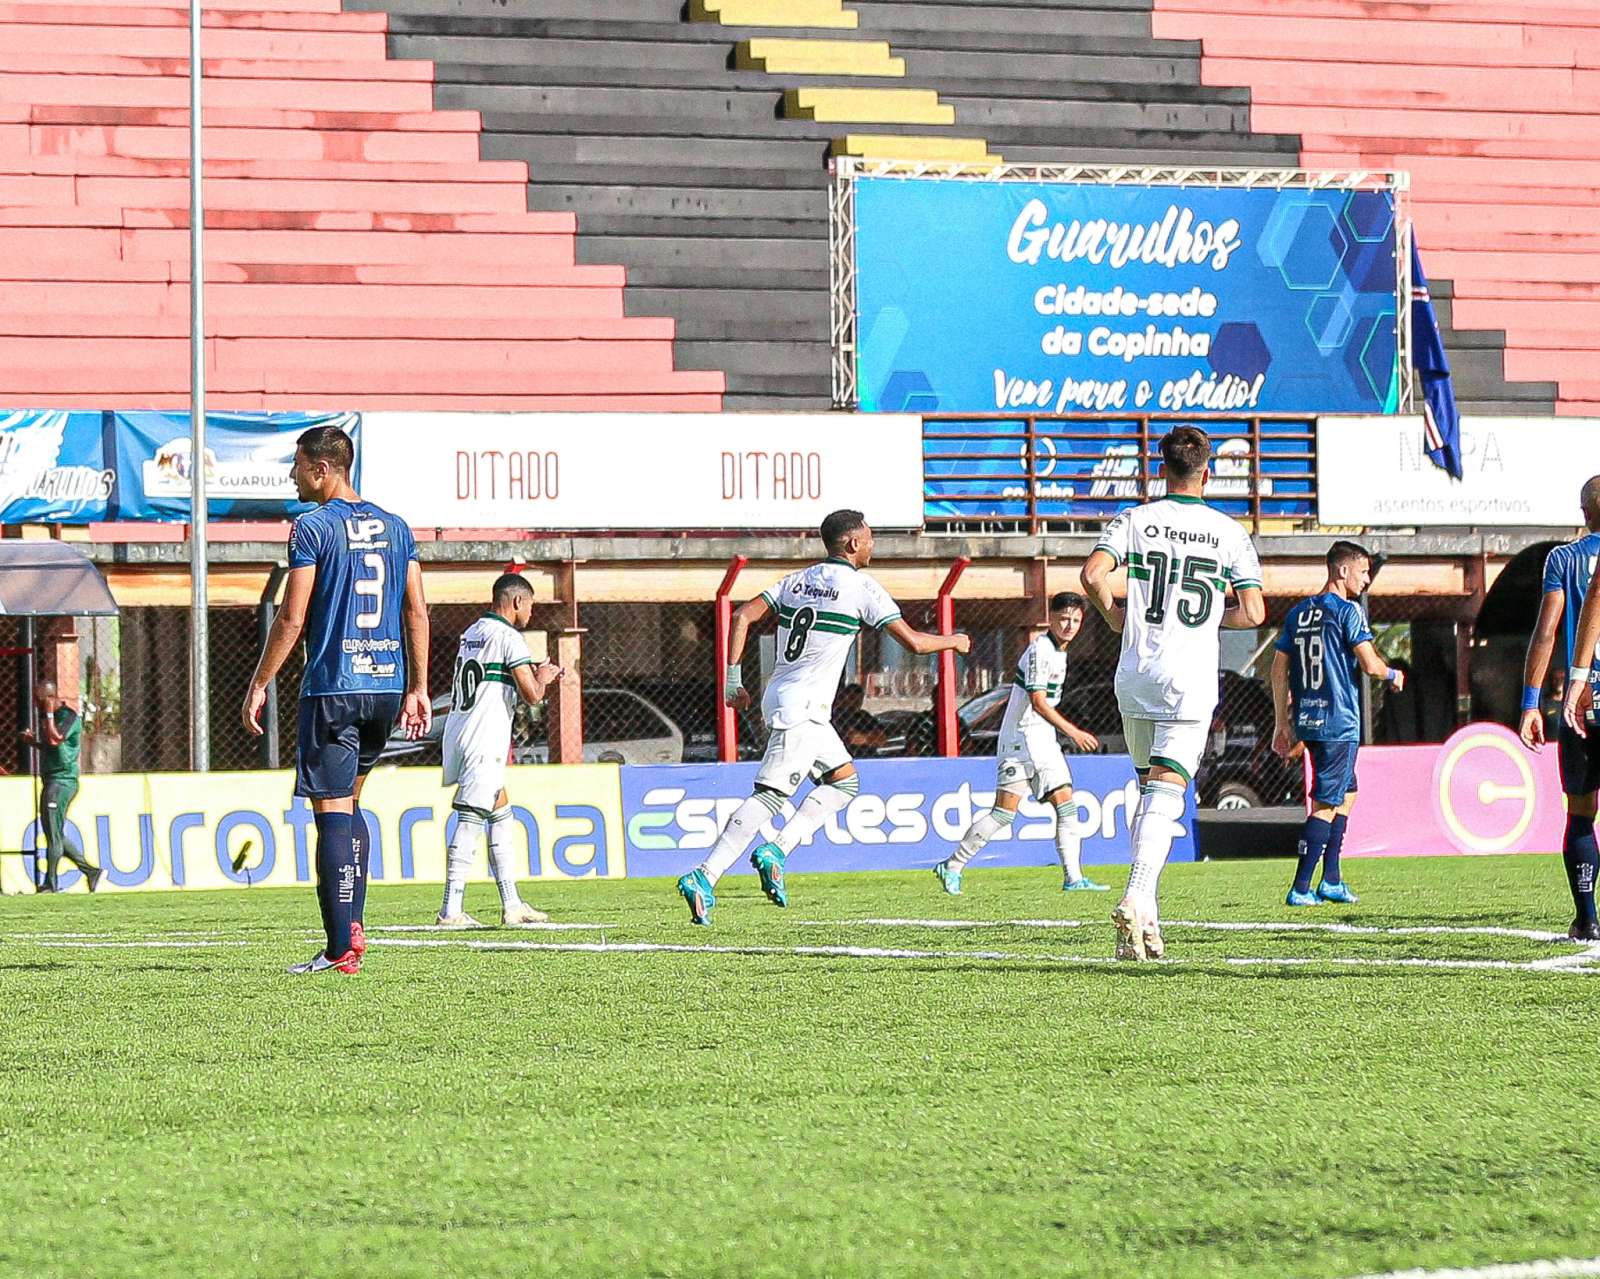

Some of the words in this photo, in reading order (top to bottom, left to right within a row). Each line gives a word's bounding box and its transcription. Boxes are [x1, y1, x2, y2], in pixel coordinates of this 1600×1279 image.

[1007, 199, 1242, 271] Guarulhos
[1033, 283, 1218, 317] Cidade-sede
[1041, 325, 1083, 356] da
[1087, 324, 1211, 363] Copinha
[993, 368, 1053, 409] Vem
[1055, 376, 1128, 415] para
[1134, 379, 1152, 408] o
[1159, 369, 1265, 411] estádio!
[1399, 431, 1504, 472] NPA
[456, 451, 559, 500] DITADO
[721, 452, 821, 500] DITADO
[1374, 498, 1443, 513] assentos
[1450, 498, 1531, 515] esportivos
[346, 519, 386, 542] UP
[1164, 526, 1219, 548] Tequaly
[354, 552, 386, 630] 3
[803, 584, 840, 601] Tequaly
[1145, 551, 1218, 629] 15
[784, 606, 816, 663] 8
[451, 656, 485, 711] 10
[1294, 635, 1324, 691] 18
